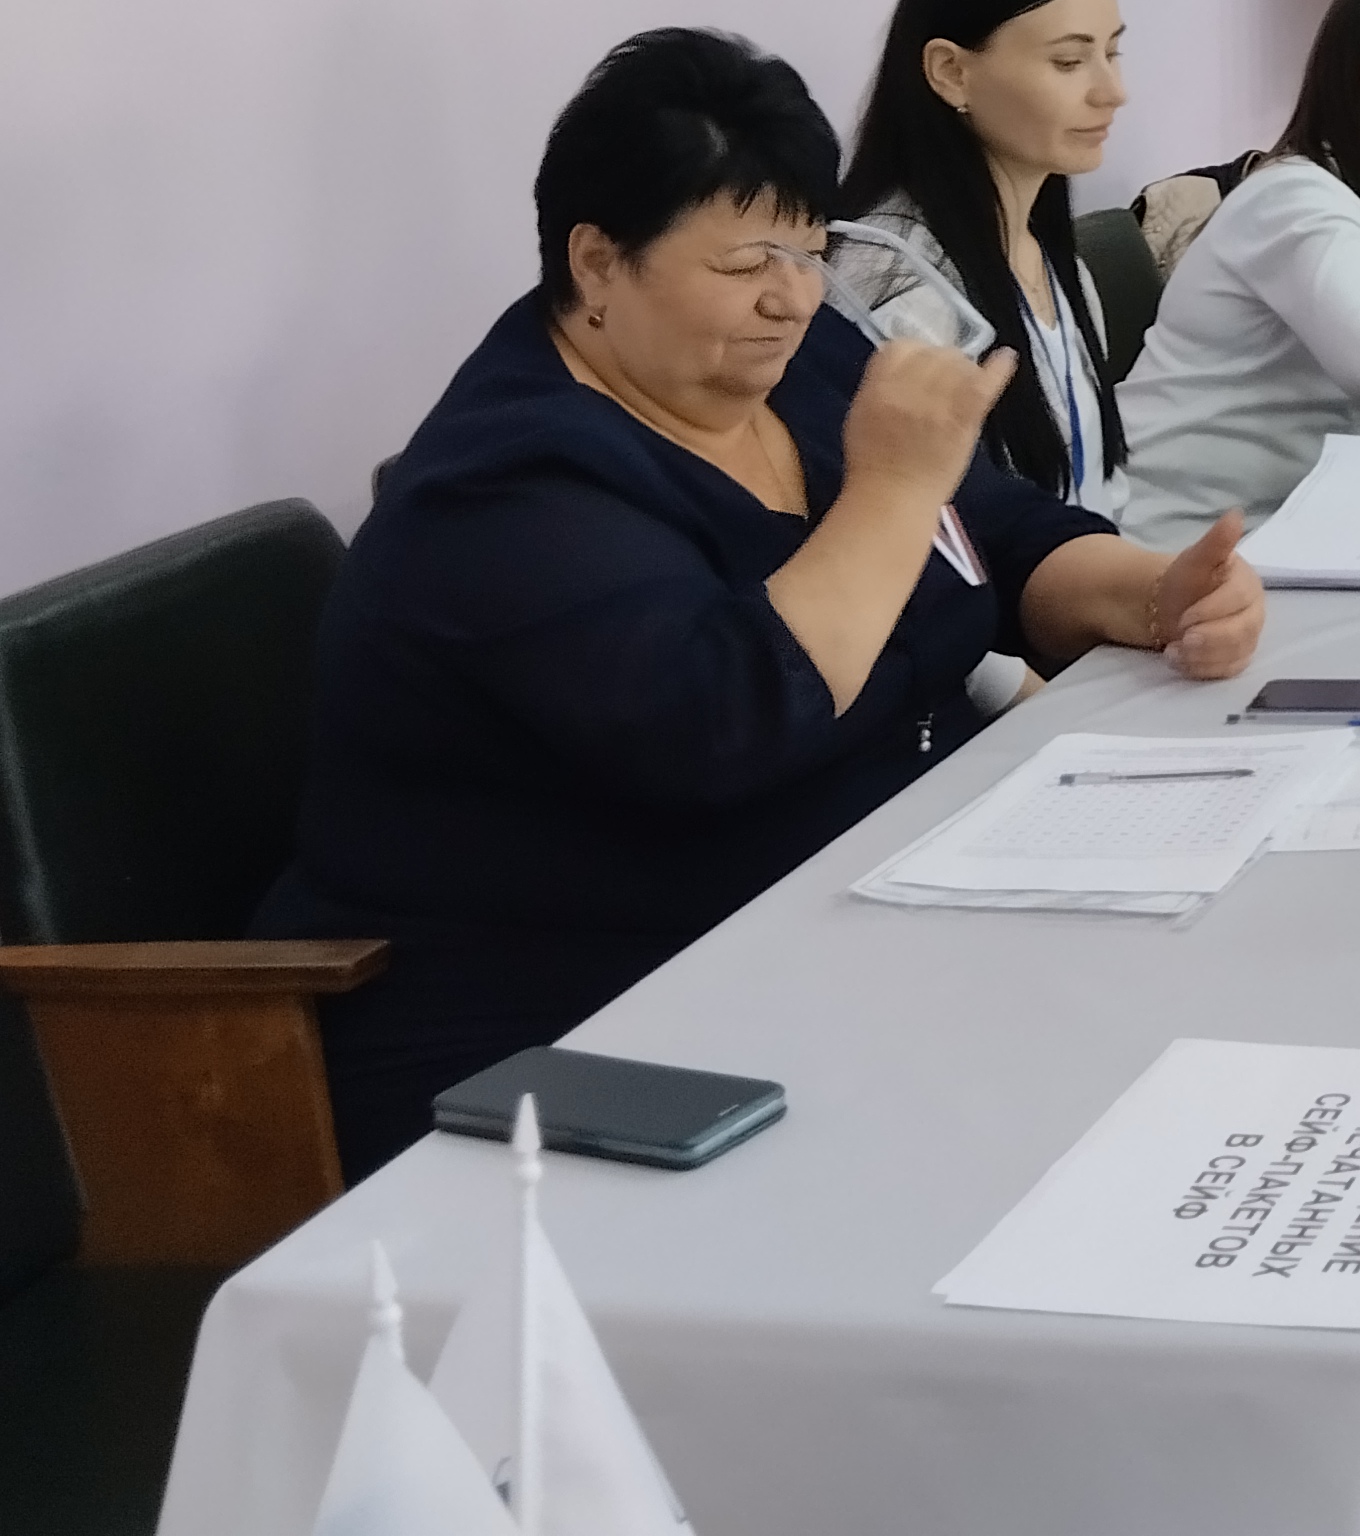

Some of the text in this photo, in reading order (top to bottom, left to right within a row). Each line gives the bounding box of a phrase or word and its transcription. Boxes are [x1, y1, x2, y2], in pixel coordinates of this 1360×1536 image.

[1172, 1132, 1264, 1220] В СЕЙФ
[1195, 1093, 1352, 1268] СЕЙФ-ПАКЕТОВ
